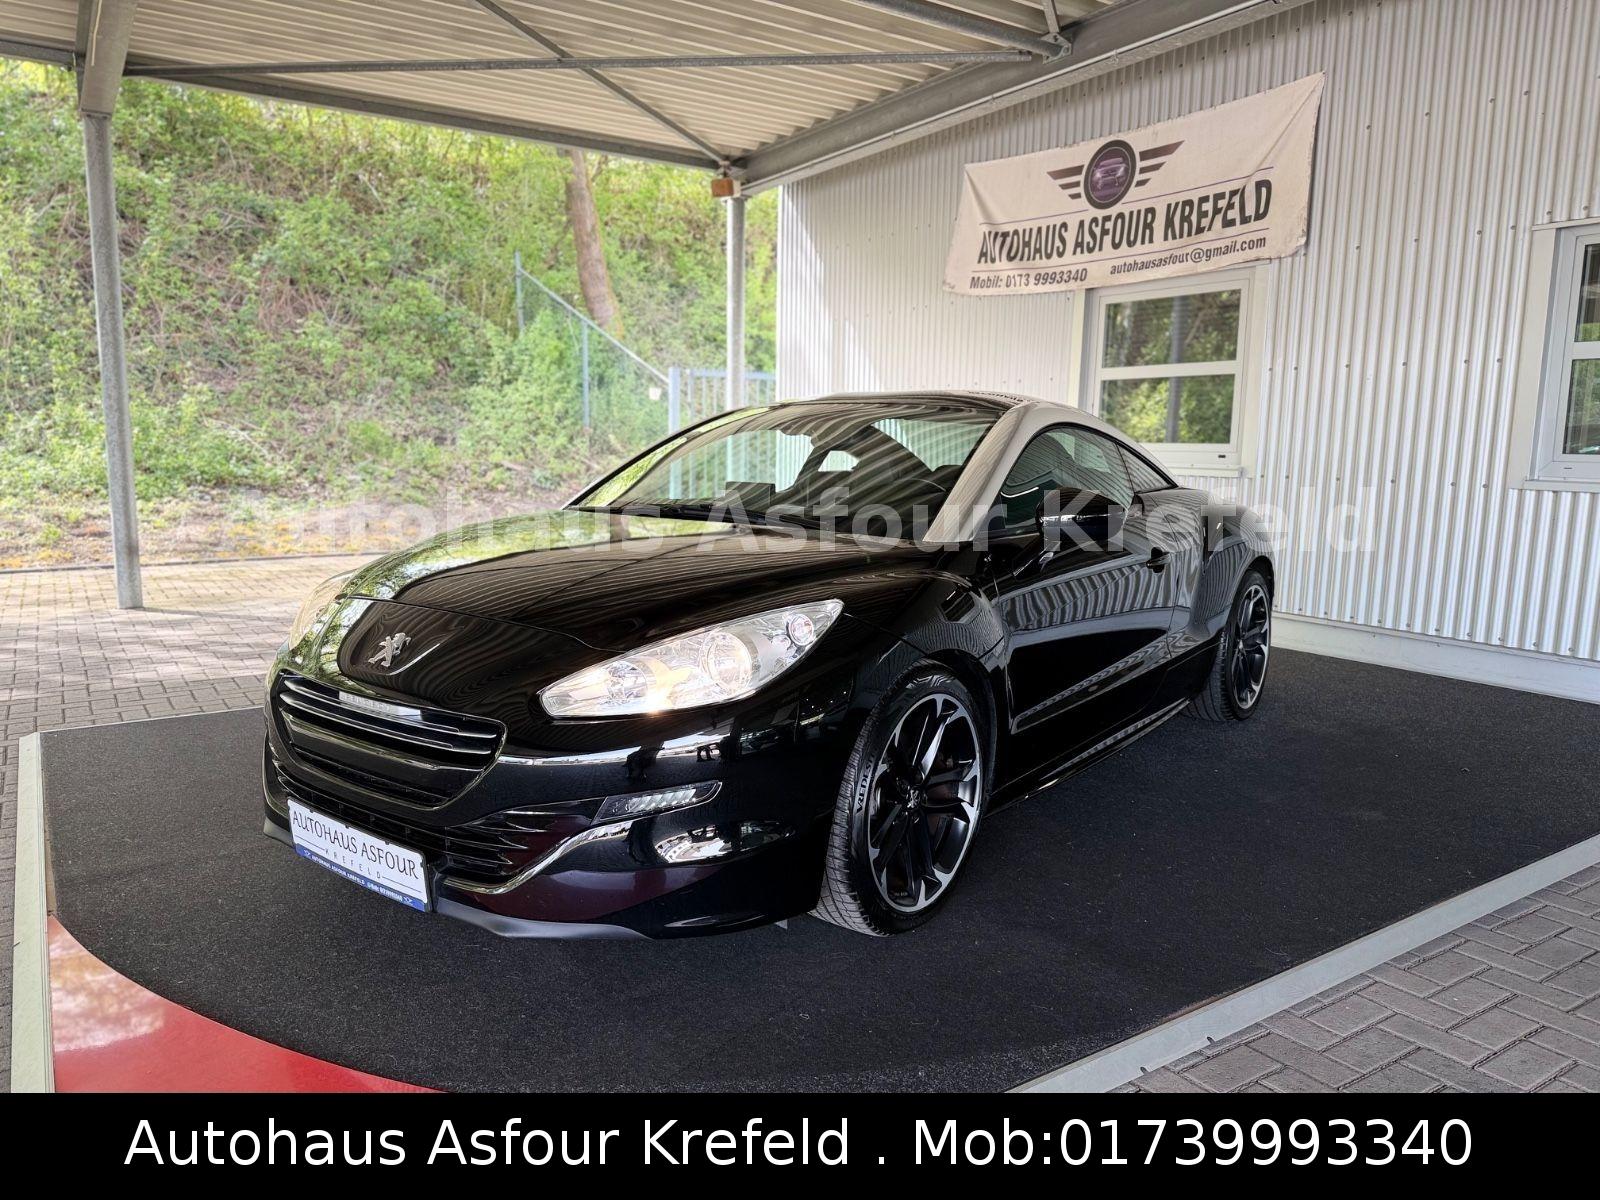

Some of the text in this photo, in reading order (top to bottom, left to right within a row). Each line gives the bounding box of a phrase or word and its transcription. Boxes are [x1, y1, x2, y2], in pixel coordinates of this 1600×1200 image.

[977, 179, 1272, 264] AUTOHAUS ASFOUR KREFELD
[970, 267, 1088, 290] Mobil: 0173 9993340
[1110, 236, 1266, 275] autohausasfour@gmail.com
[292, 811, 357, 853] AUTOHAUS
[361, 842, 419, 880] ASFOUR
